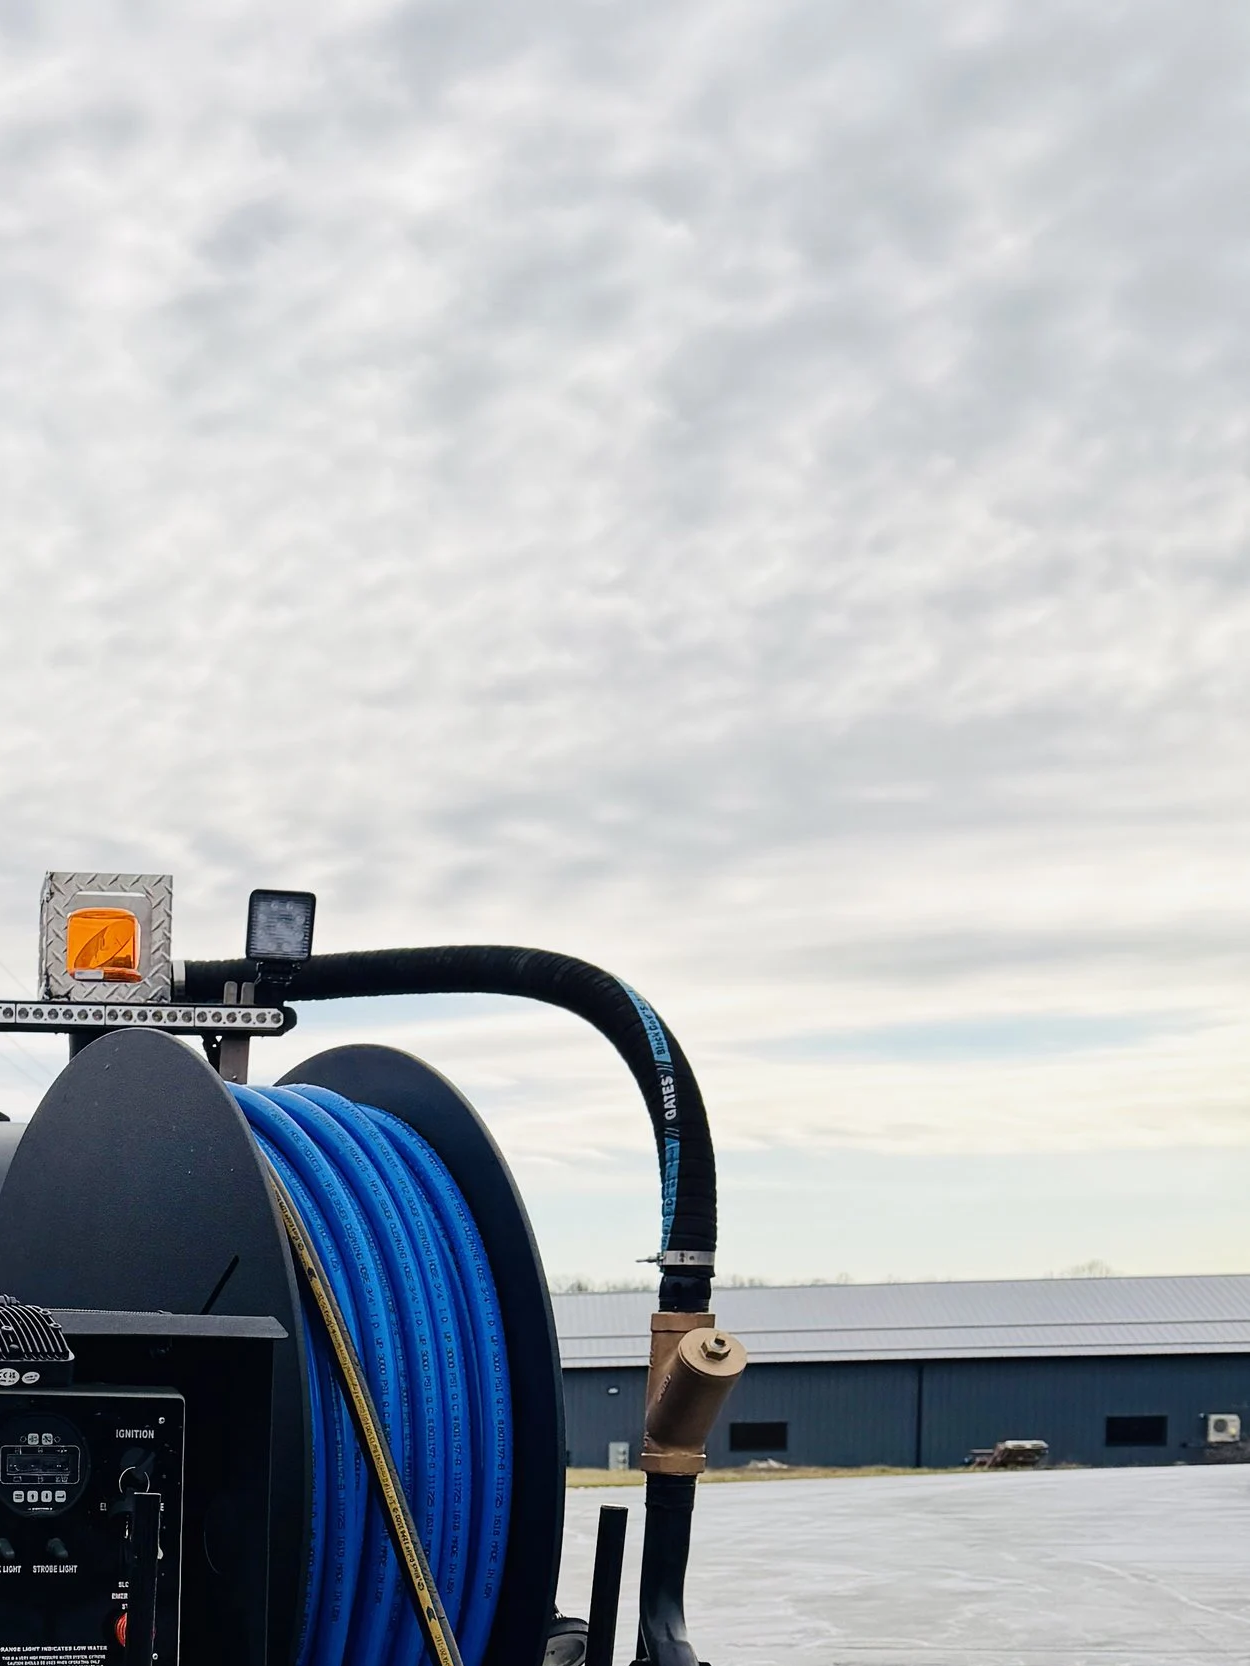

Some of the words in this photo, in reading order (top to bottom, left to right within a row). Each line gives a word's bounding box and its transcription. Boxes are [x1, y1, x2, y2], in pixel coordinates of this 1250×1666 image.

[661, 1075, 677, 1120] GATES
[116, 1429, 154, 1439] IGNITION
[3, 1565, 21, 1573] LIGHT
[32, 1565, 58, 1573] STROBE
[59, 1565, 78, 1573] LIGHT
